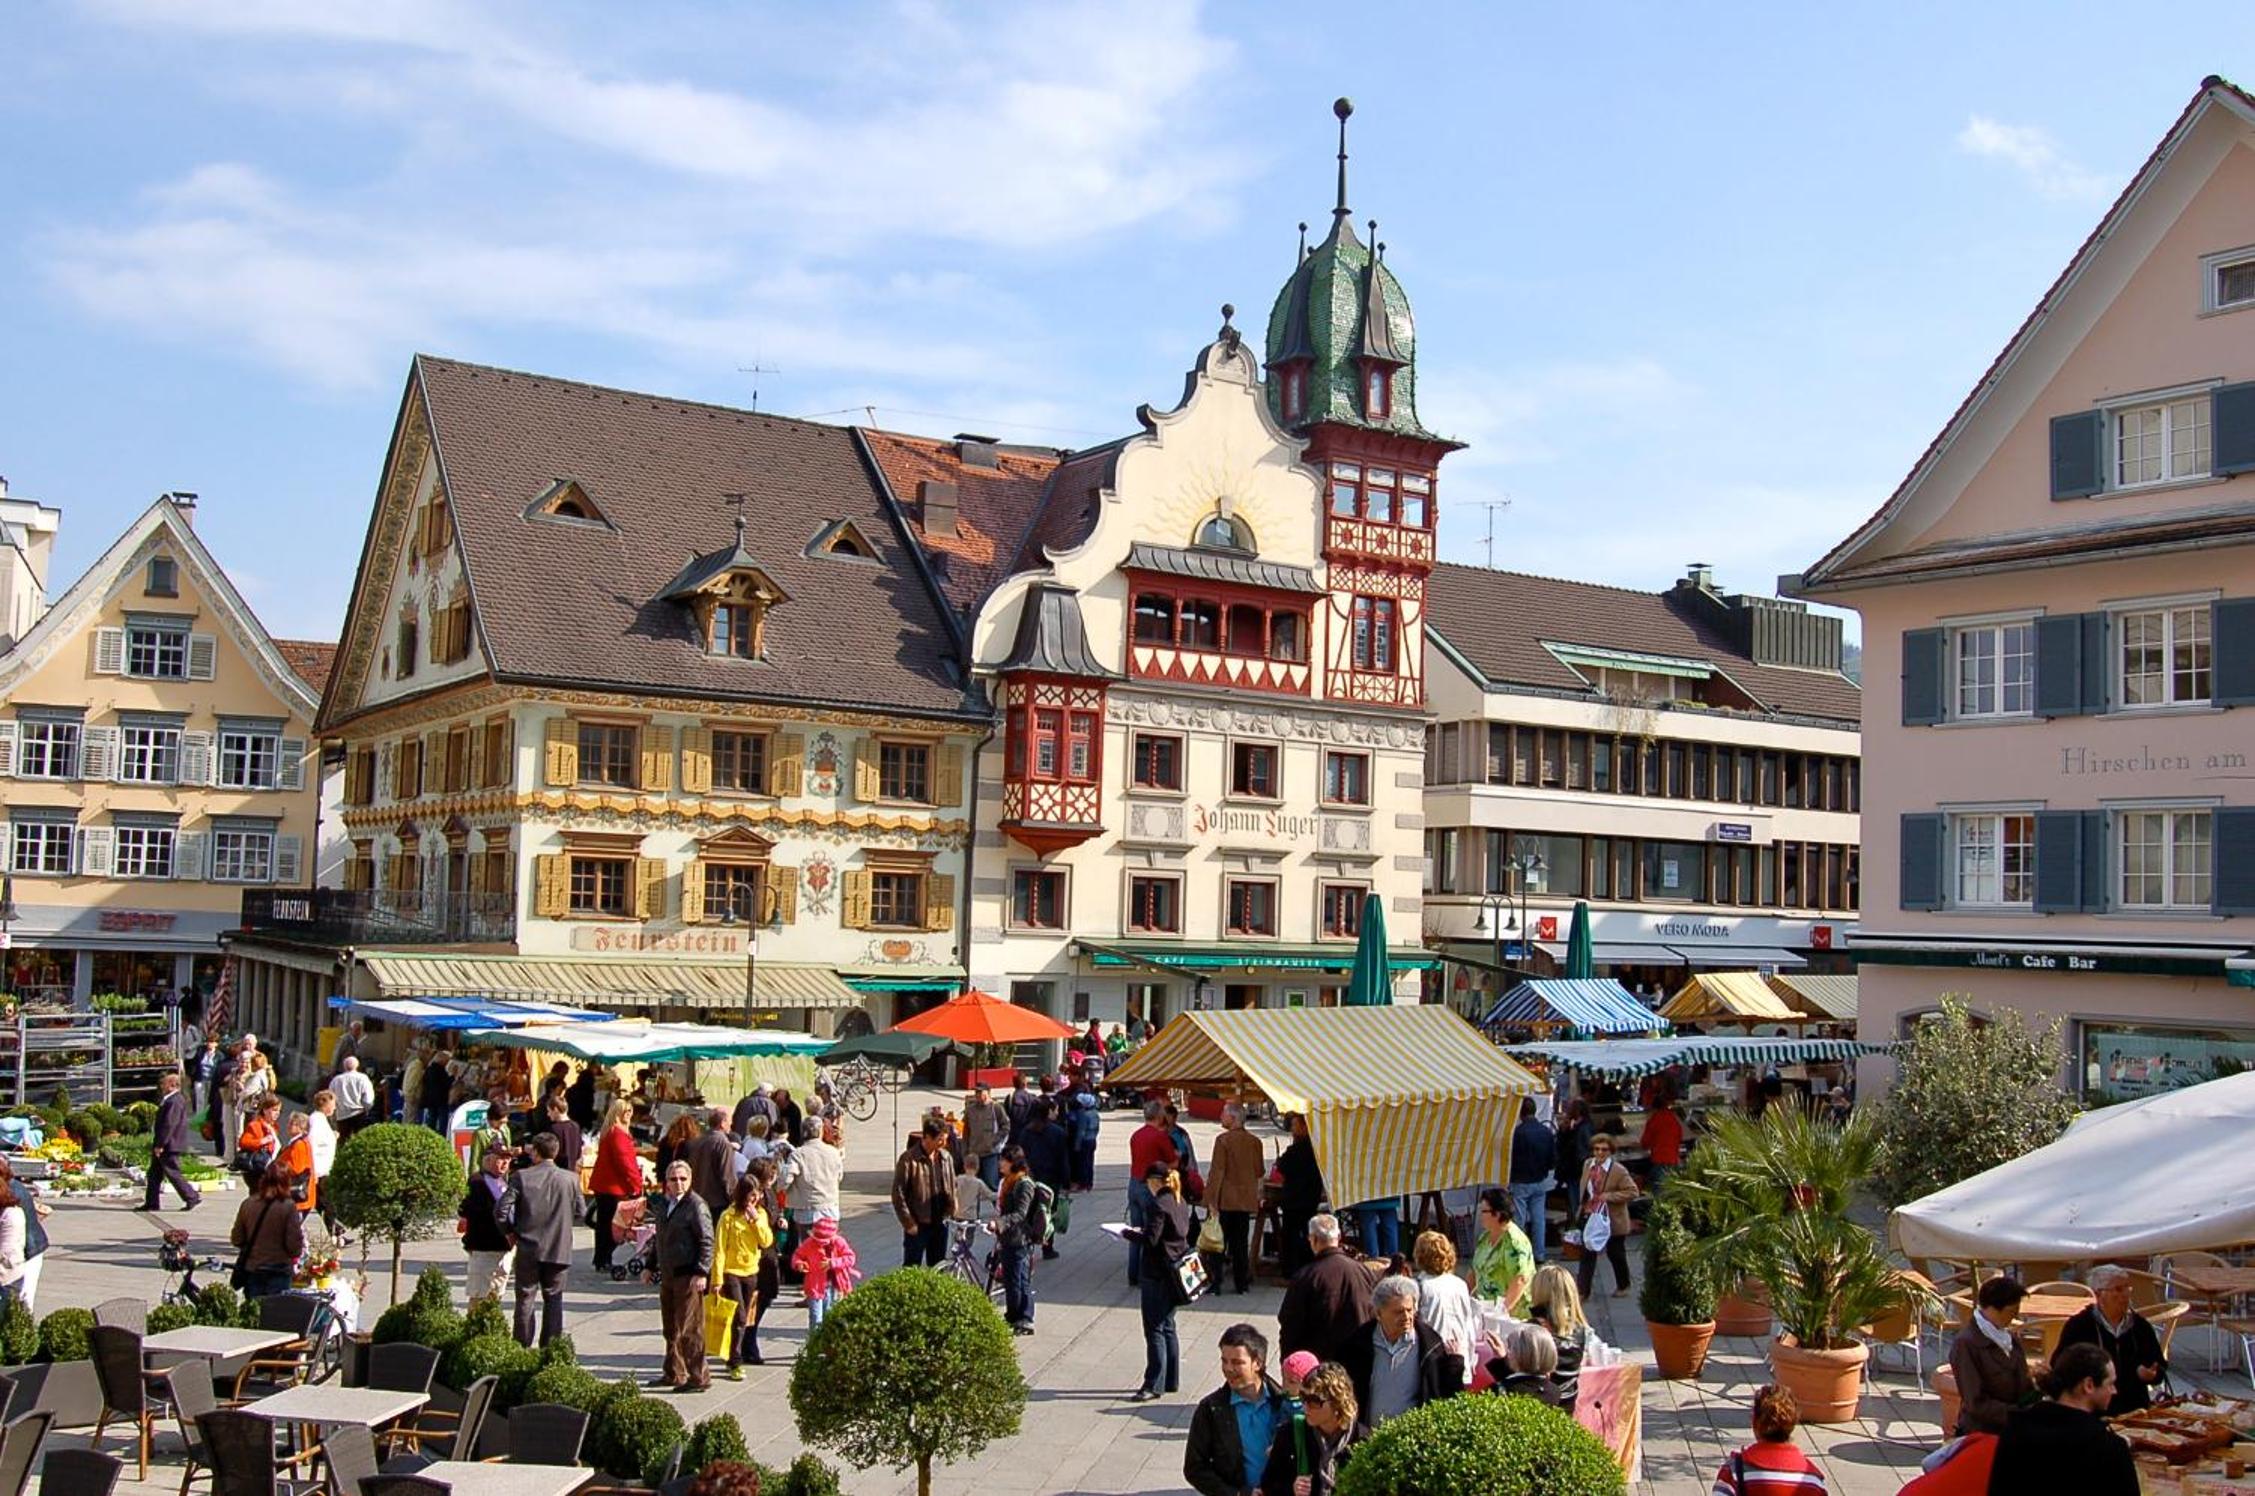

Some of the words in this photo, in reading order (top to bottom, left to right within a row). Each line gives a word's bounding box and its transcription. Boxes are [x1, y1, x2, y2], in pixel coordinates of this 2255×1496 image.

[2061, 745, 2190, 774] Hirschen
[2206, 752, 2247, 769] am
[1193, 804, 1261, 834] Johann
[1265, 809, 1318, 841] Luger
[594, 926, 737, 952] Feurstein
[1655, 923, 1689, 936] VERO
[1692, 923, 1730, 937] MODA
[2022, 954, 2056, 968] Cafe
[2068, 955, 2097, 970] Bar
